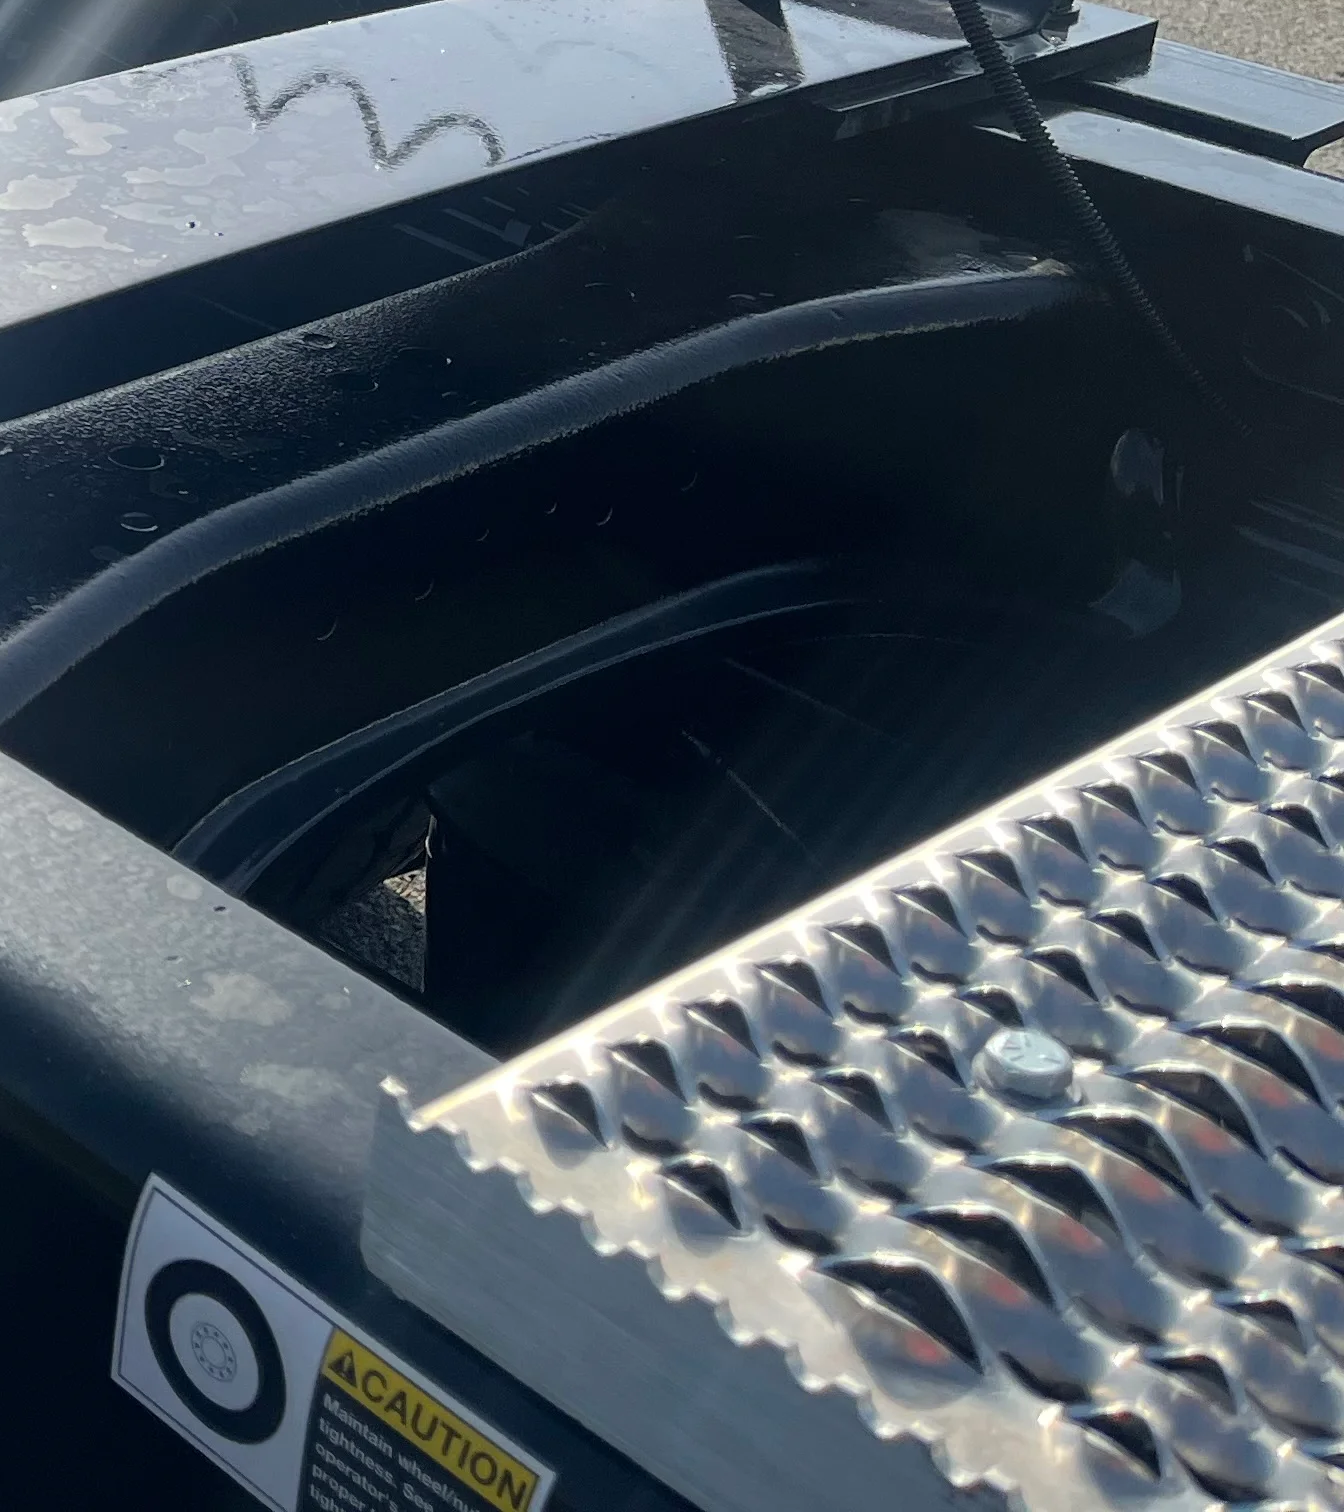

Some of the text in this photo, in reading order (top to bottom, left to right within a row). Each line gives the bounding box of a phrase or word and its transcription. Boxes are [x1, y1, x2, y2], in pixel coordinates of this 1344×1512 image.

[324, 1392, 480, 1512] Maintain wheel/n
[362, 1370, 527, 1510] CAUTION
[313, 1463, 365, 1511] proper
[315, 1443, 399, 1512] operator's
[403, 1482, 433, 1512] See
